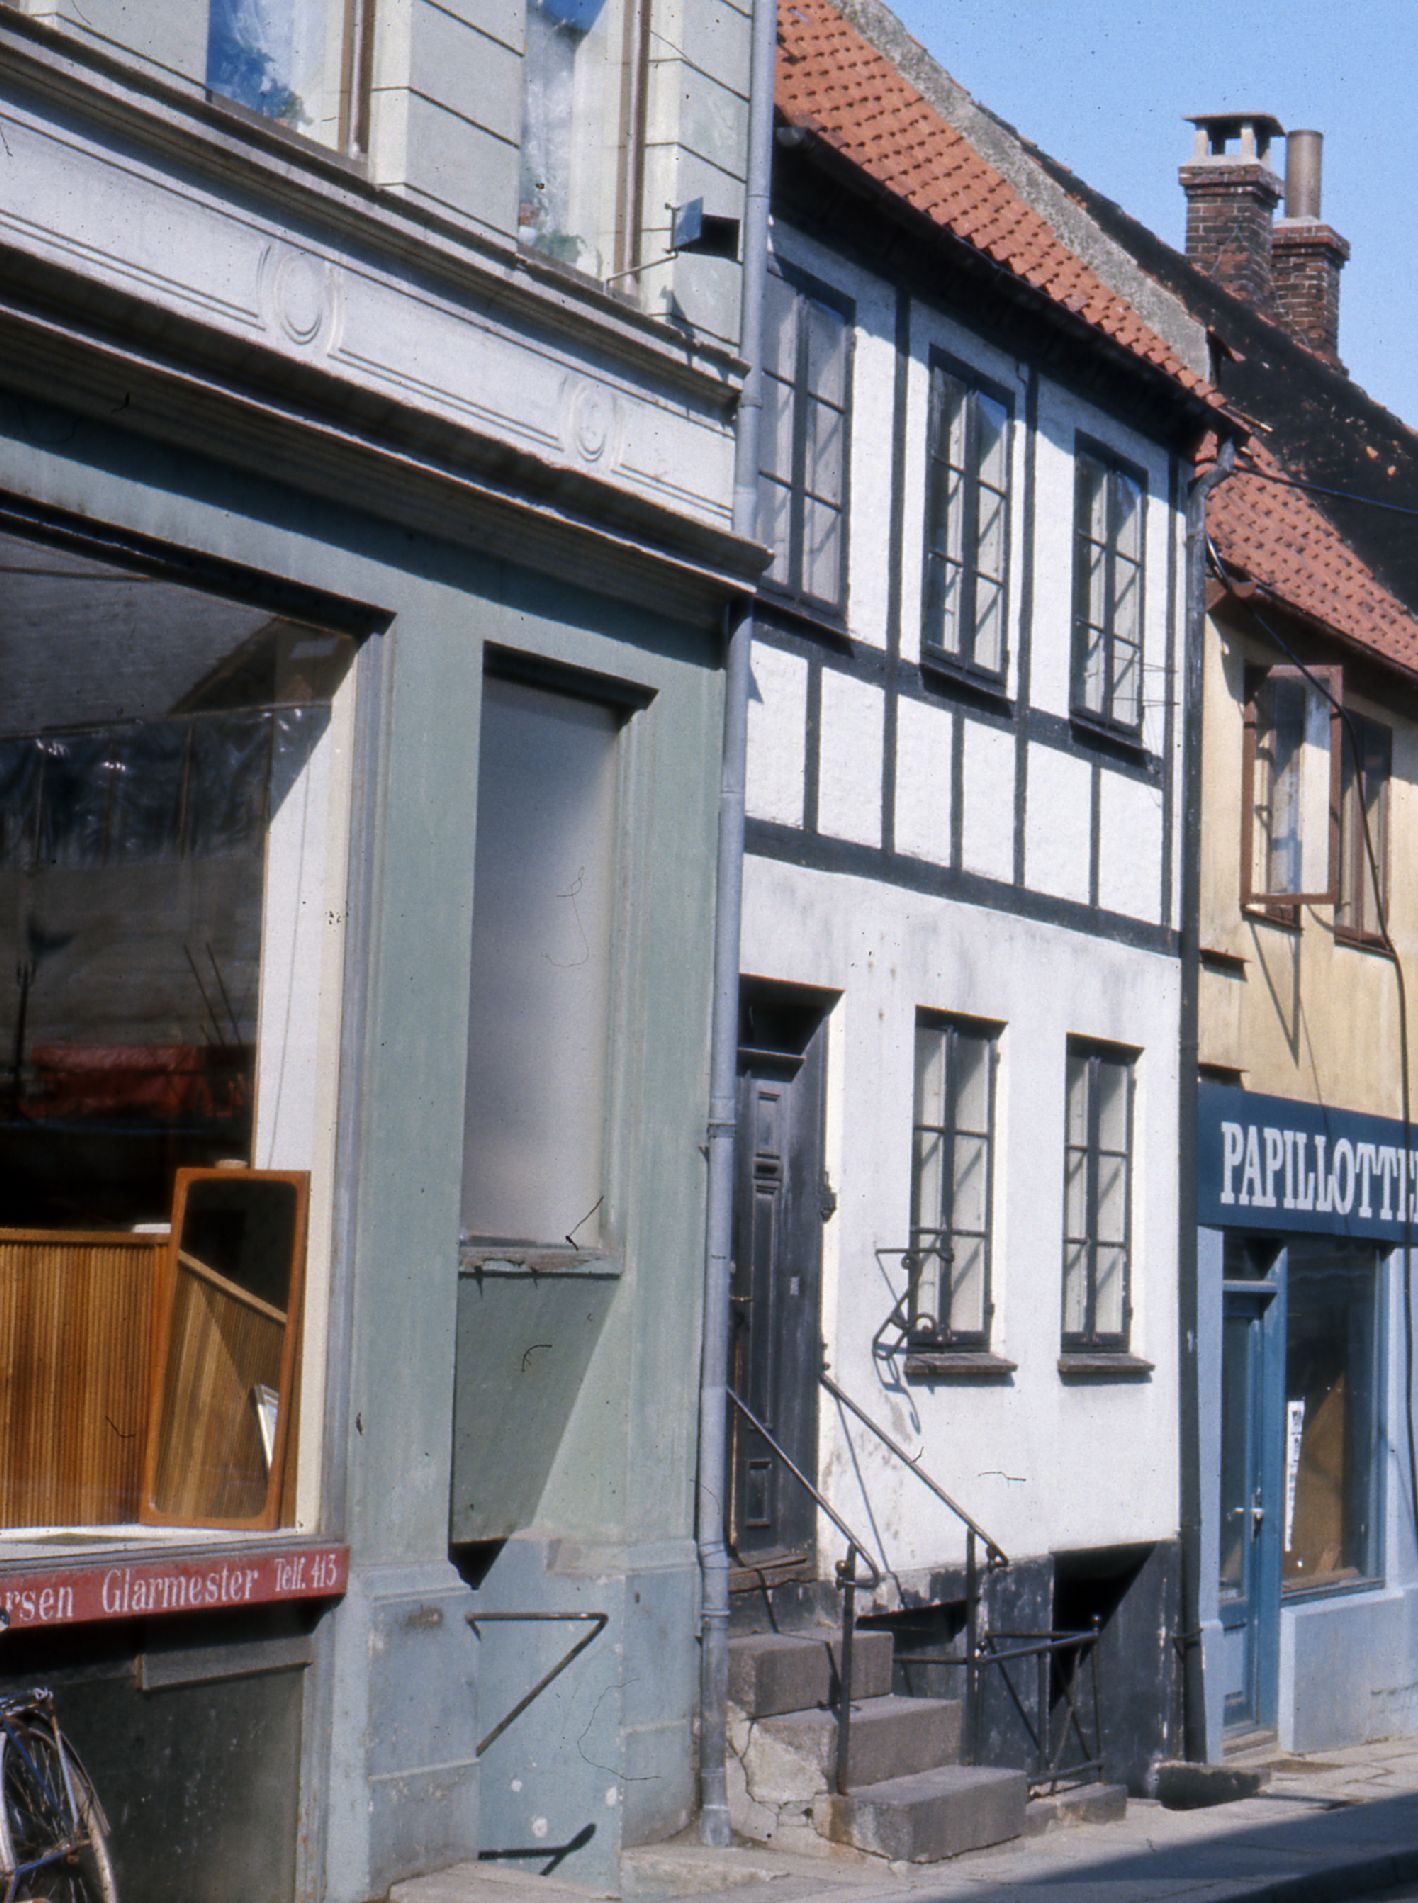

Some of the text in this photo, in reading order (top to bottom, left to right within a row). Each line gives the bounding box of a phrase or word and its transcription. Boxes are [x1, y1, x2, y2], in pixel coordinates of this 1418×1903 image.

[0, 1553, 338, 1622] rsen Glarmester Telf. 413
